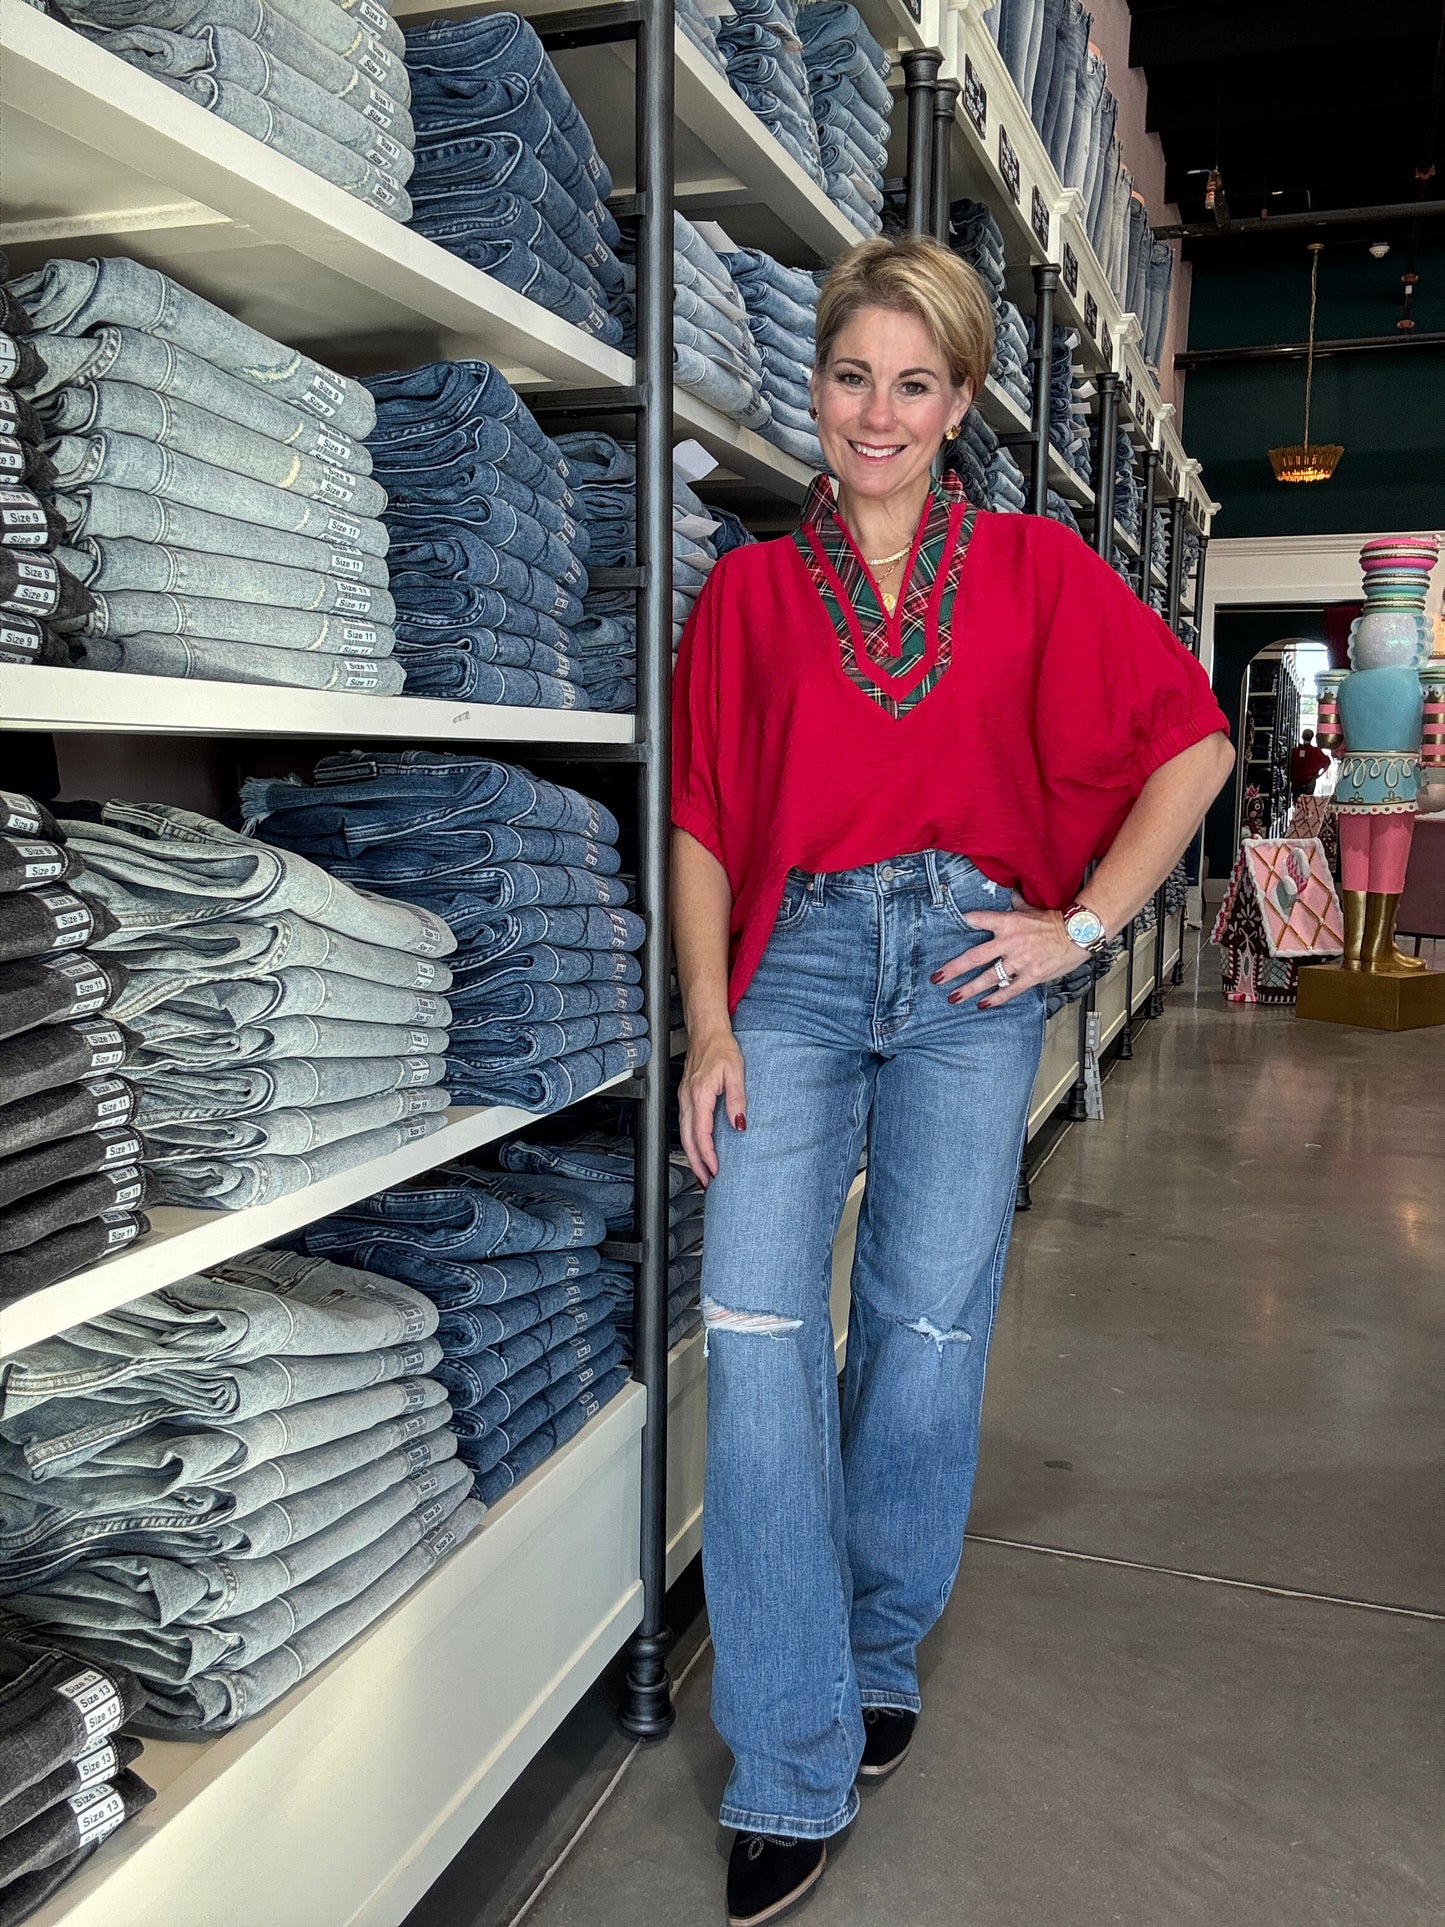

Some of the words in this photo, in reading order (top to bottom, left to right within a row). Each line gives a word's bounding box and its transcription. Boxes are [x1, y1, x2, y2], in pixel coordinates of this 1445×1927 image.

[365, 6, 378, 21] Size
[364, 60, 377, 74] Size
[368, 110, 381, 121] Size
[381, 138, 392, 152] Size
[376, 186, 388, 200] Size
[2, 365, 8, 374] 7
[318, 382, 333, 397] Size
[4, 400, 10, 410] 9
[308, 396, 323, 410] Size
[2, 422, 9, 431] 9
[323, 439, 339, 452] Size
[340, 448, 345, 456] 9
[10, 456, 15, 465] 9
[325, 484, 341, 496] Size
[10, 513, 31, 523] Size
[33, 513, 38, 522] 9
[332, 521, 347, 532] Size
[349, 528, 356, 536] 11
[336, 557, 350, 567] Size
[352, 562, 360, 570] 11
[24, 566, 42, 578] Size
[44, 570, 50, 579] 9
[341, 583, 356, 592] Size
[22, 589, 42, 600] Size
[43, 592, 49, 601] 9
[339, 600, 356, 608] Size
[6, 633, 25, 645] Size
[27, 637, 32, 646] 9
[347, 631, 363, 639] Size
[13, 818, 28, 829] Size
[29, 821, 34, 832] 9
[32, 867, 49, 876] Size
[51, 866, 56, 874] 9
[62, 915, 78, 926] Size
[79, 912, 84, 921] 9
[60, 934, 77, 944] Size
[77, 932, 83, 940] 9
[80, 984, 93, 993] Size
[91, 1036, 108, 1044] Size
[95, 1055, 110, 1063] Size
[93, 1085, 110, 1094] Size
[102, 1103, 117, 1113] Size
[119, 1099, 126, 1108] 11
[110, 1145, 126, 1155] Size
[127, 1142, 135, 1151] 11
[114, 1172, 126, 1181] Size
[127, 1168, 134, 1176] 11
[120, 1190, 131, 1199] Size
[132, 1187, 138, 1195] 11
[112, 1230, 125, 1240] Size
[127, 1227, 133, 1236] 11
[65, 1682, 86, 1693] Size
[80, 1694, 99, 1708] Size
[99, 1684, 111, 1696] 13
[89, 1712, 106, 1728] Size
[107, 1703, 117, 1716] 13
[82, 1760, 100, 1775] Size
[102, 1753, 111, 1765] 13
[74, 1792, 96, 1808] Size
[96, 1786, 108, 1794] 13
[83, 1810, 104, 1827] Size
[107, 1800, 119, 1813] 13
